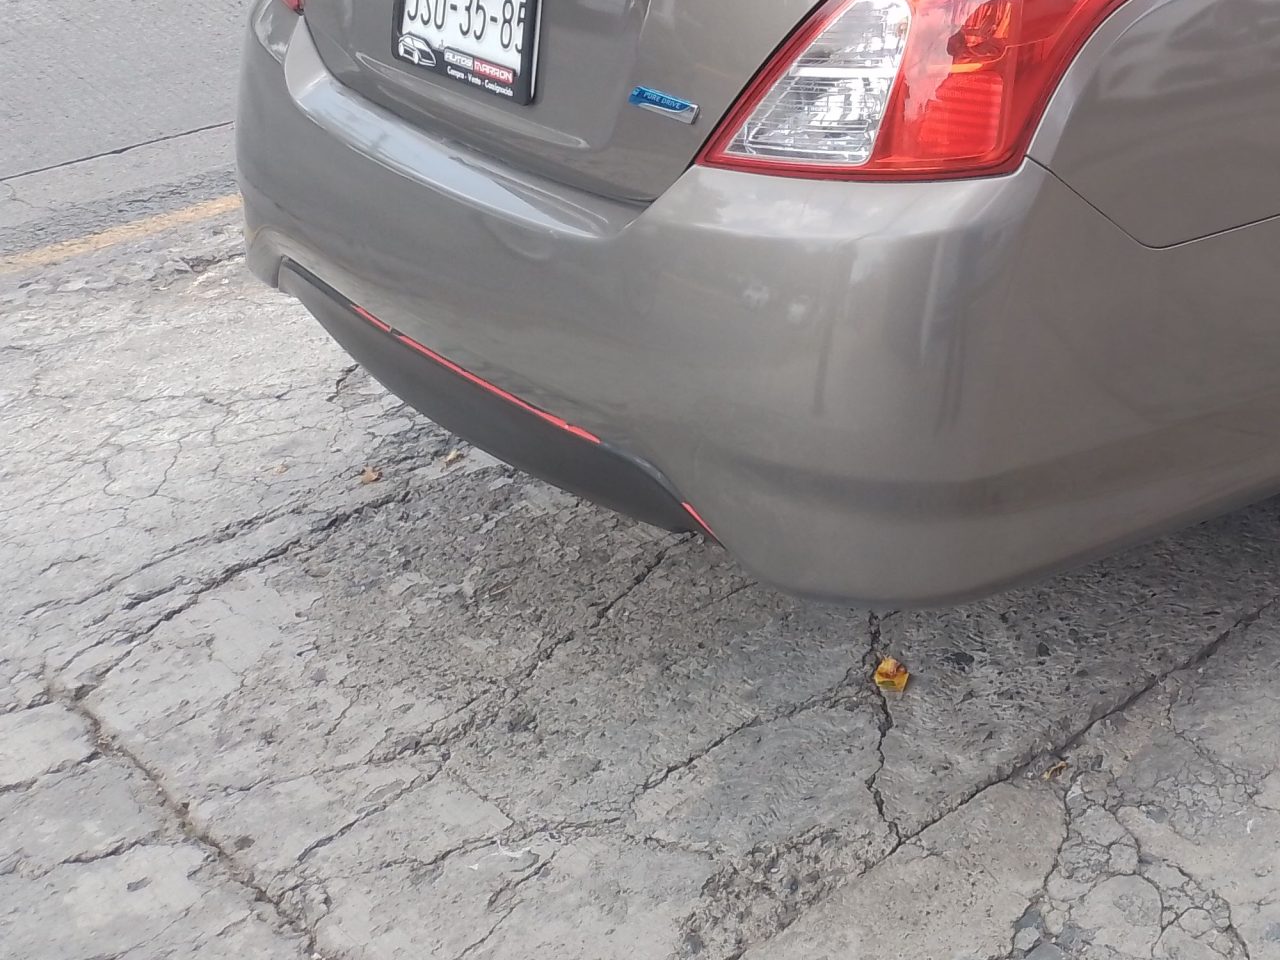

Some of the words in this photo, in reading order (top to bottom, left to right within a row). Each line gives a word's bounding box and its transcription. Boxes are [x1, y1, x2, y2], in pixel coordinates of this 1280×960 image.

[445, 51, 473, 67] AUTOS
[643, 91, 660, 103] PURE
[661, 98, 682, 109] DRIVE
